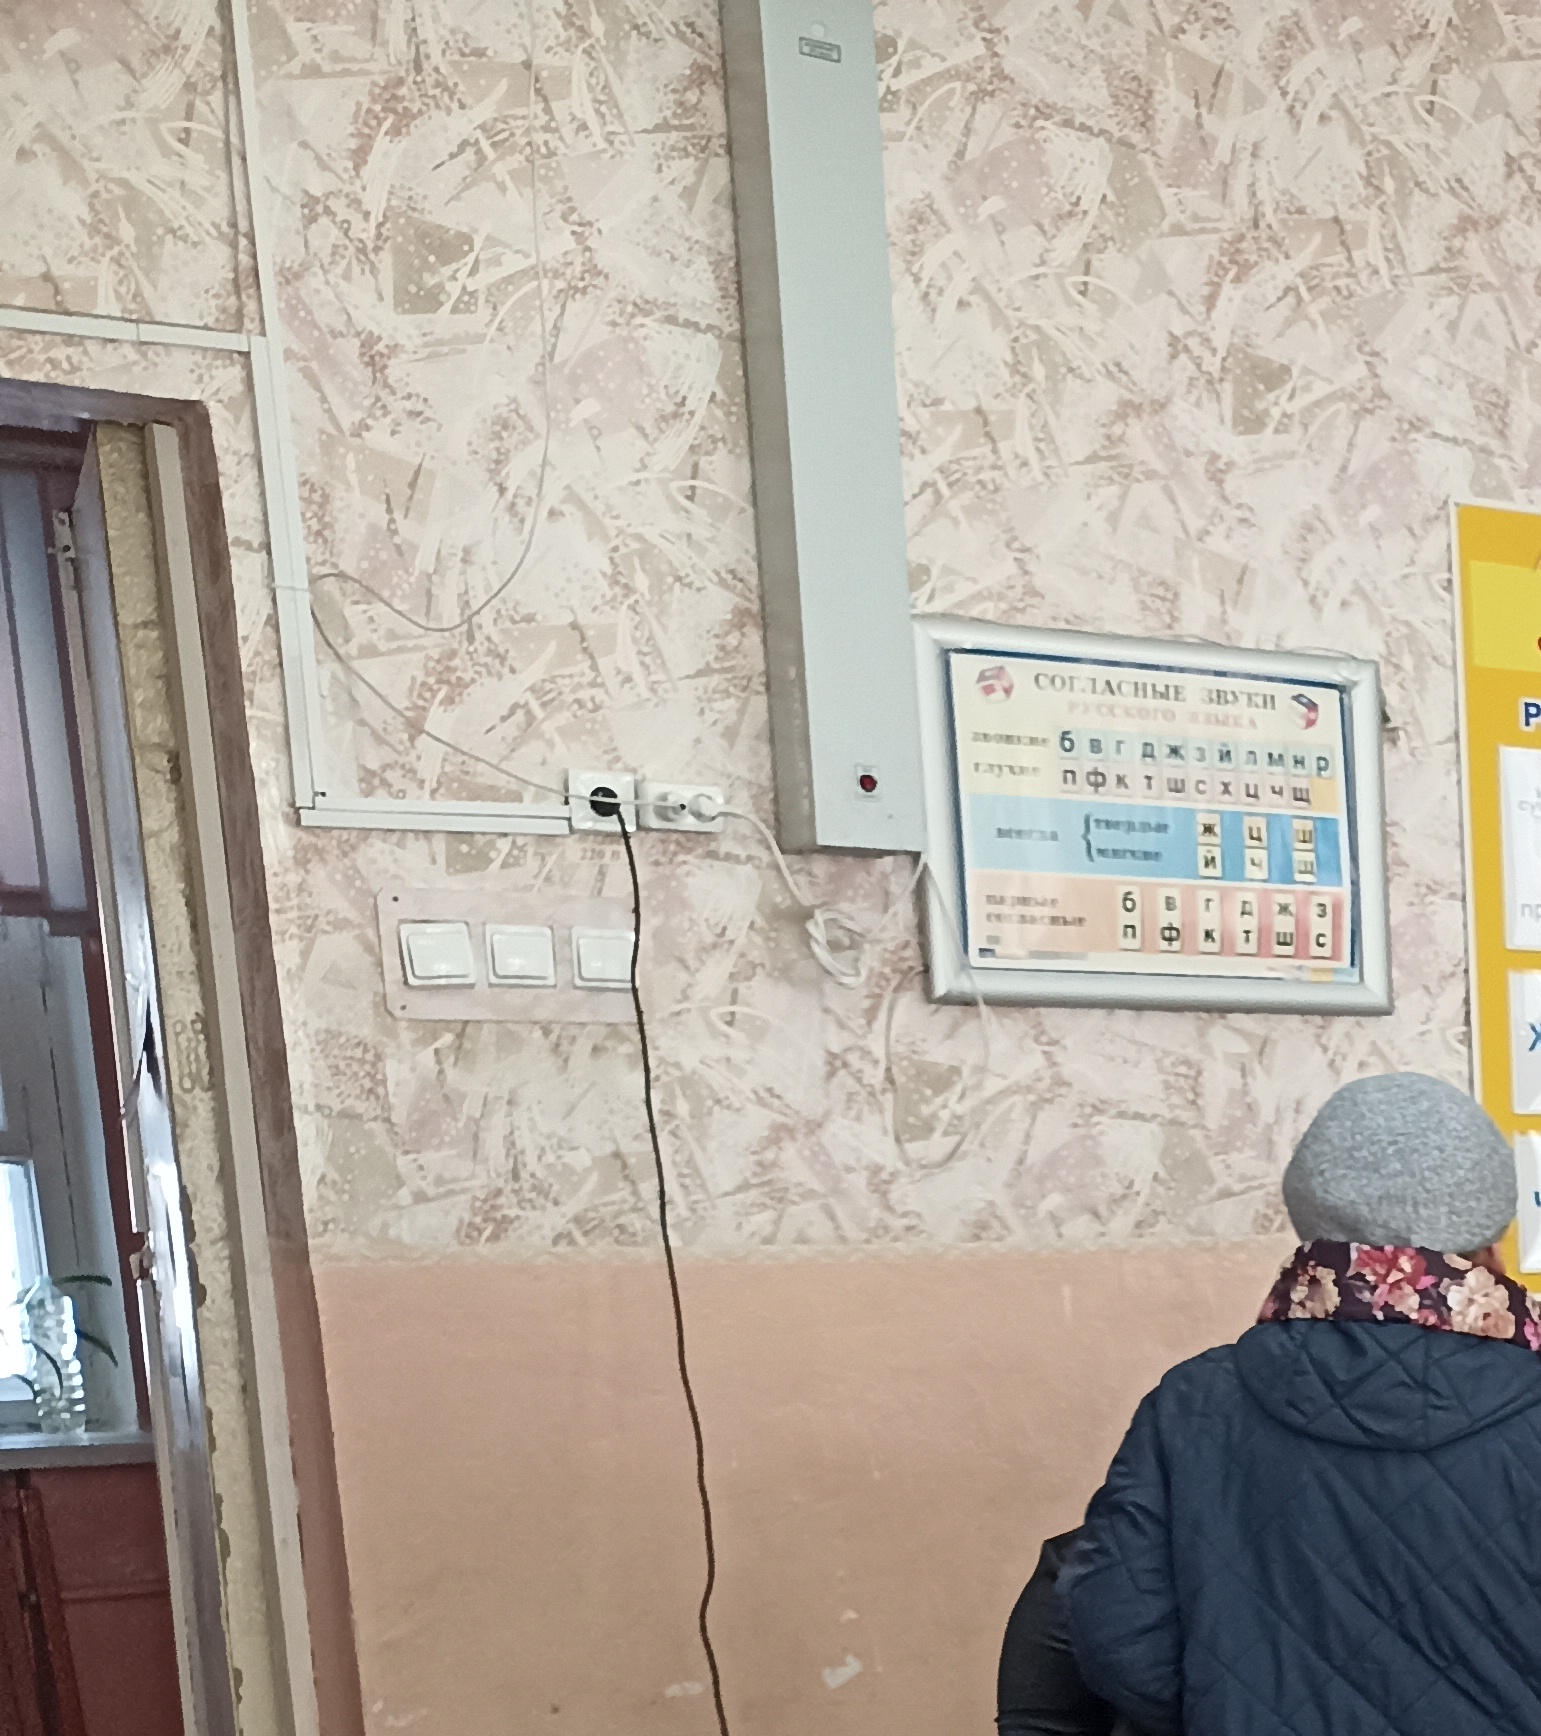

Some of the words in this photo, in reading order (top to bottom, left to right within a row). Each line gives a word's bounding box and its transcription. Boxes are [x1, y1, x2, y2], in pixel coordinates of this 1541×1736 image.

[1034, 672, 1186, 702] СОГЛАСНЫЕ
[1199, 687, 1276, 711] ЗВУКИ
[1059, 730, 1075, 752] б
[1062, 769, 1077, 785] п
[1086, 767, 1107, 791] ф
[1194, 779, 1207, 795] с
[1121, 891, 1137, 913] б
[1122, 924, 1137, 940] п
[1160, 921, 1181, 946] ф
[1315, 932, 1327, 948] с
